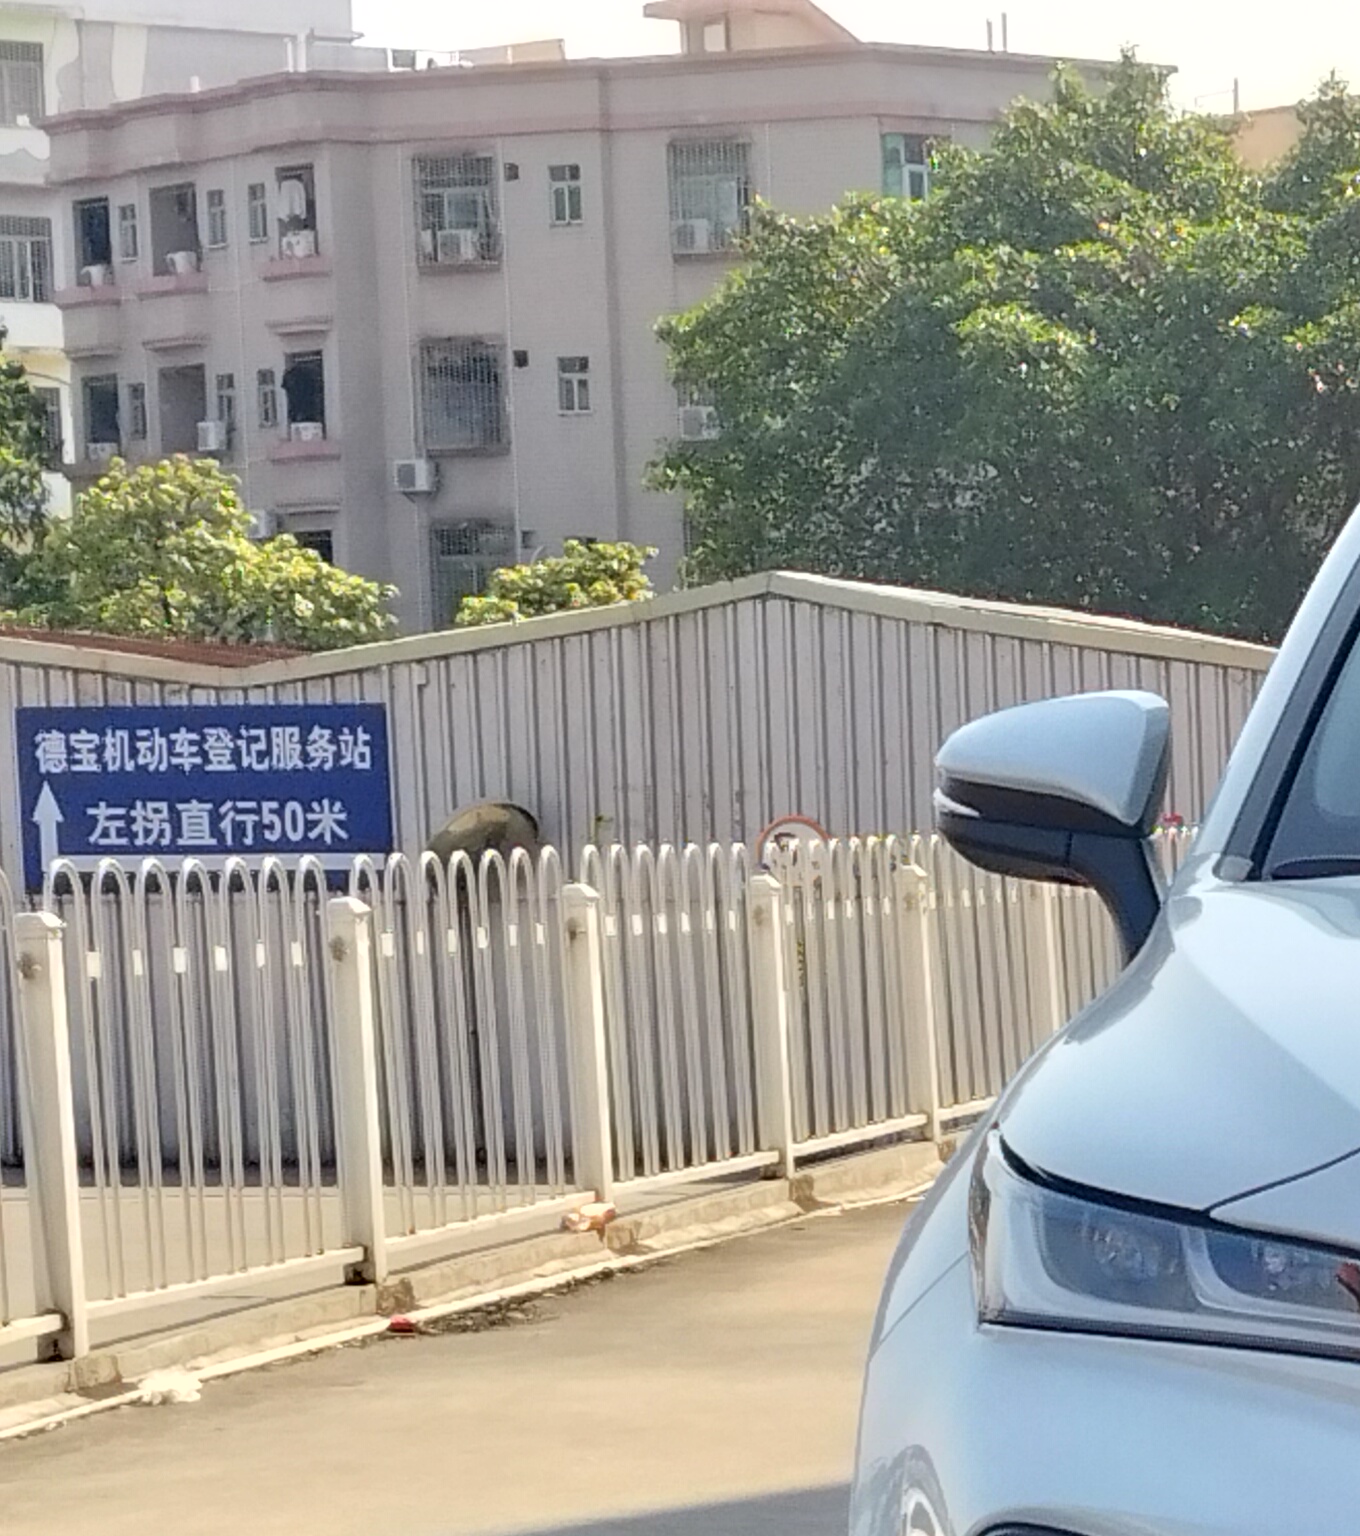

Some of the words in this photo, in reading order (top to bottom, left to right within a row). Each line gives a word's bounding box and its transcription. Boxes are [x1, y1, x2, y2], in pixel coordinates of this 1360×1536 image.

[34, 725, 372, 774] 德宝机动车登记服务站
[86, 798, 349, 846] 左拐直行50米
